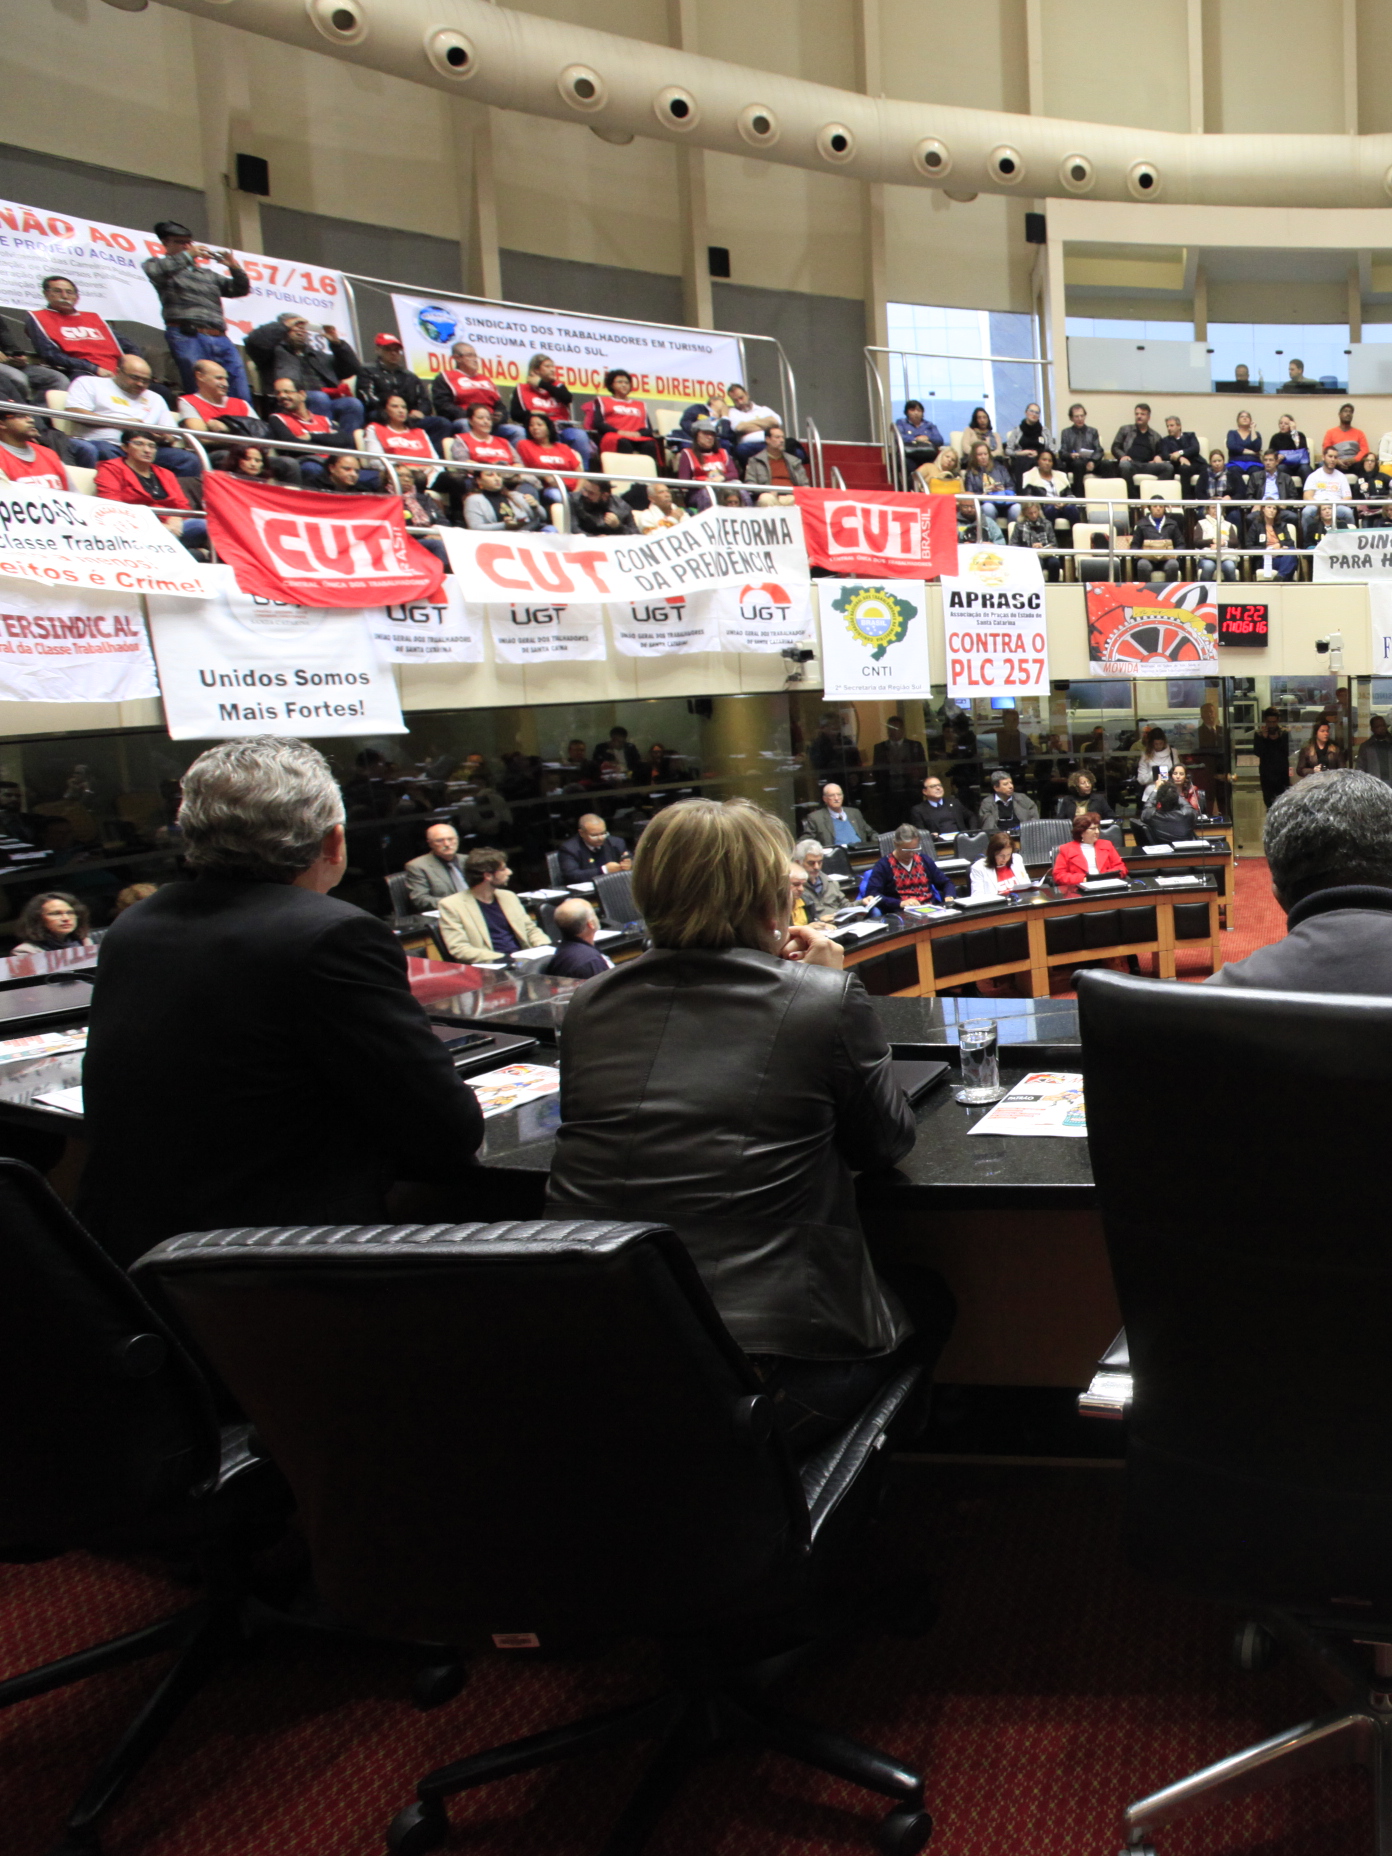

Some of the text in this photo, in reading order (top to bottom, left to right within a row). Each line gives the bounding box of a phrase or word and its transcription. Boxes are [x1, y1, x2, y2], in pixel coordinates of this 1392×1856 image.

[88, 225, 138, 253] AO
[89, 249, 138, 270] ACABA
[226, 260, 338, 296] 57/16
[464, 316, 714, 354] SINDICATO DOS TRABALHADORES EM TURISMO
[468, 332, 609, 358] CRICIÚMA E REGIÃO SUL.
[481, 354, 520, 381] NÃO
[555, 365, 610, 394] EDUÇ
[655, 375, 727, 400] DIREITOS
[829, 504, 920, 555] CUT
[920, 508, 932, 560] BRASIL
[262, 517, 395, 576] CUT
[614, 529, 703, 574] CONTRA
[474, 541, 612, 594] CUT
[1328, 552, 1373, 570] PARA
[89, 569, 106, 586] é
[115, 570, 206, 594] Crime!
[634, 570, 672, 592] DA
[949, 590, 1042, 610] APRASC
[384, 604, 449, 625] UGT
[510, 607, 568, 626] UGT
[631, 605, 687, 623] UGT
[738, 604, 793, 622] UGT
[860, 619, 888, 627] BRASIL
[17, 641, 34, 655] da
[34, 642, 73, 655] Classe
[948, 631, 1046, 654] CONTRA O
[199, 668, 371, 689] Unidos Somos
[861, 665, 893, 677] CNTI
[950, 657, 1046, 686] PLC 257
[1102, 662, 1139, 675] MOVIDA
[887, 683, 910, 692] Região
[911, 683, 922, 691] Sul
[218, 698, 366, 721] Mais Fortes!
